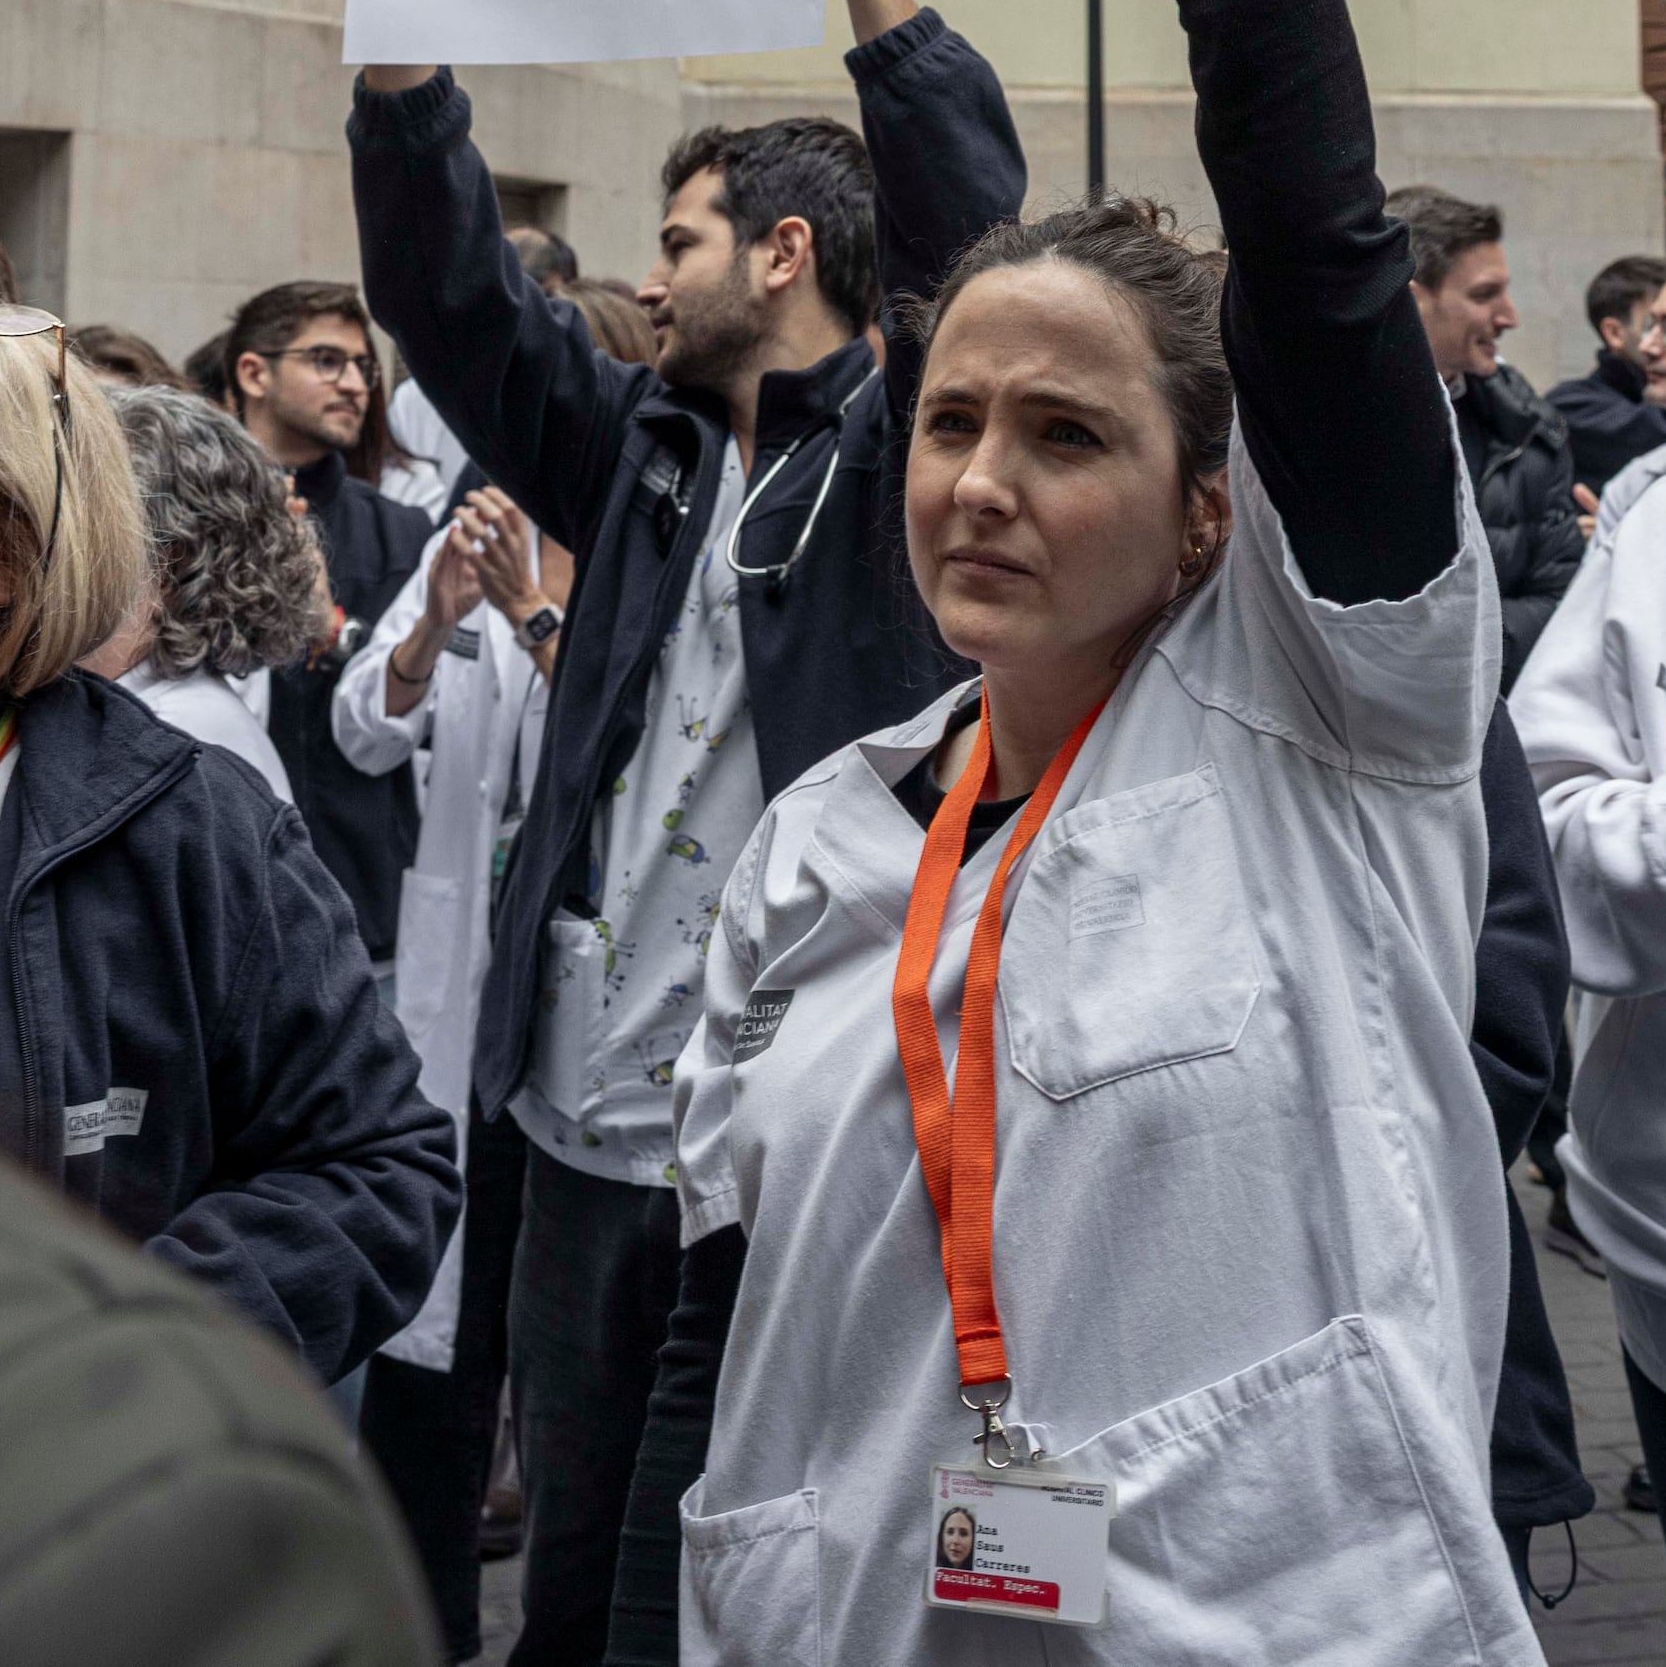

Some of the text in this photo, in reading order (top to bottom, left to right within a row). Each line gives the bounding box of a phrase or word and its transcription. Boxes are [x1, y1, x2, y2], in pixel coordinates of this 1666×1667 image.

[745, 1003, 788, 1018] ALITAT
[976, 1525, 998, 1535] Ana
[976, 1541, 1004, 1552] Saus
[975, 1558, 1030, 1573] Carreres
